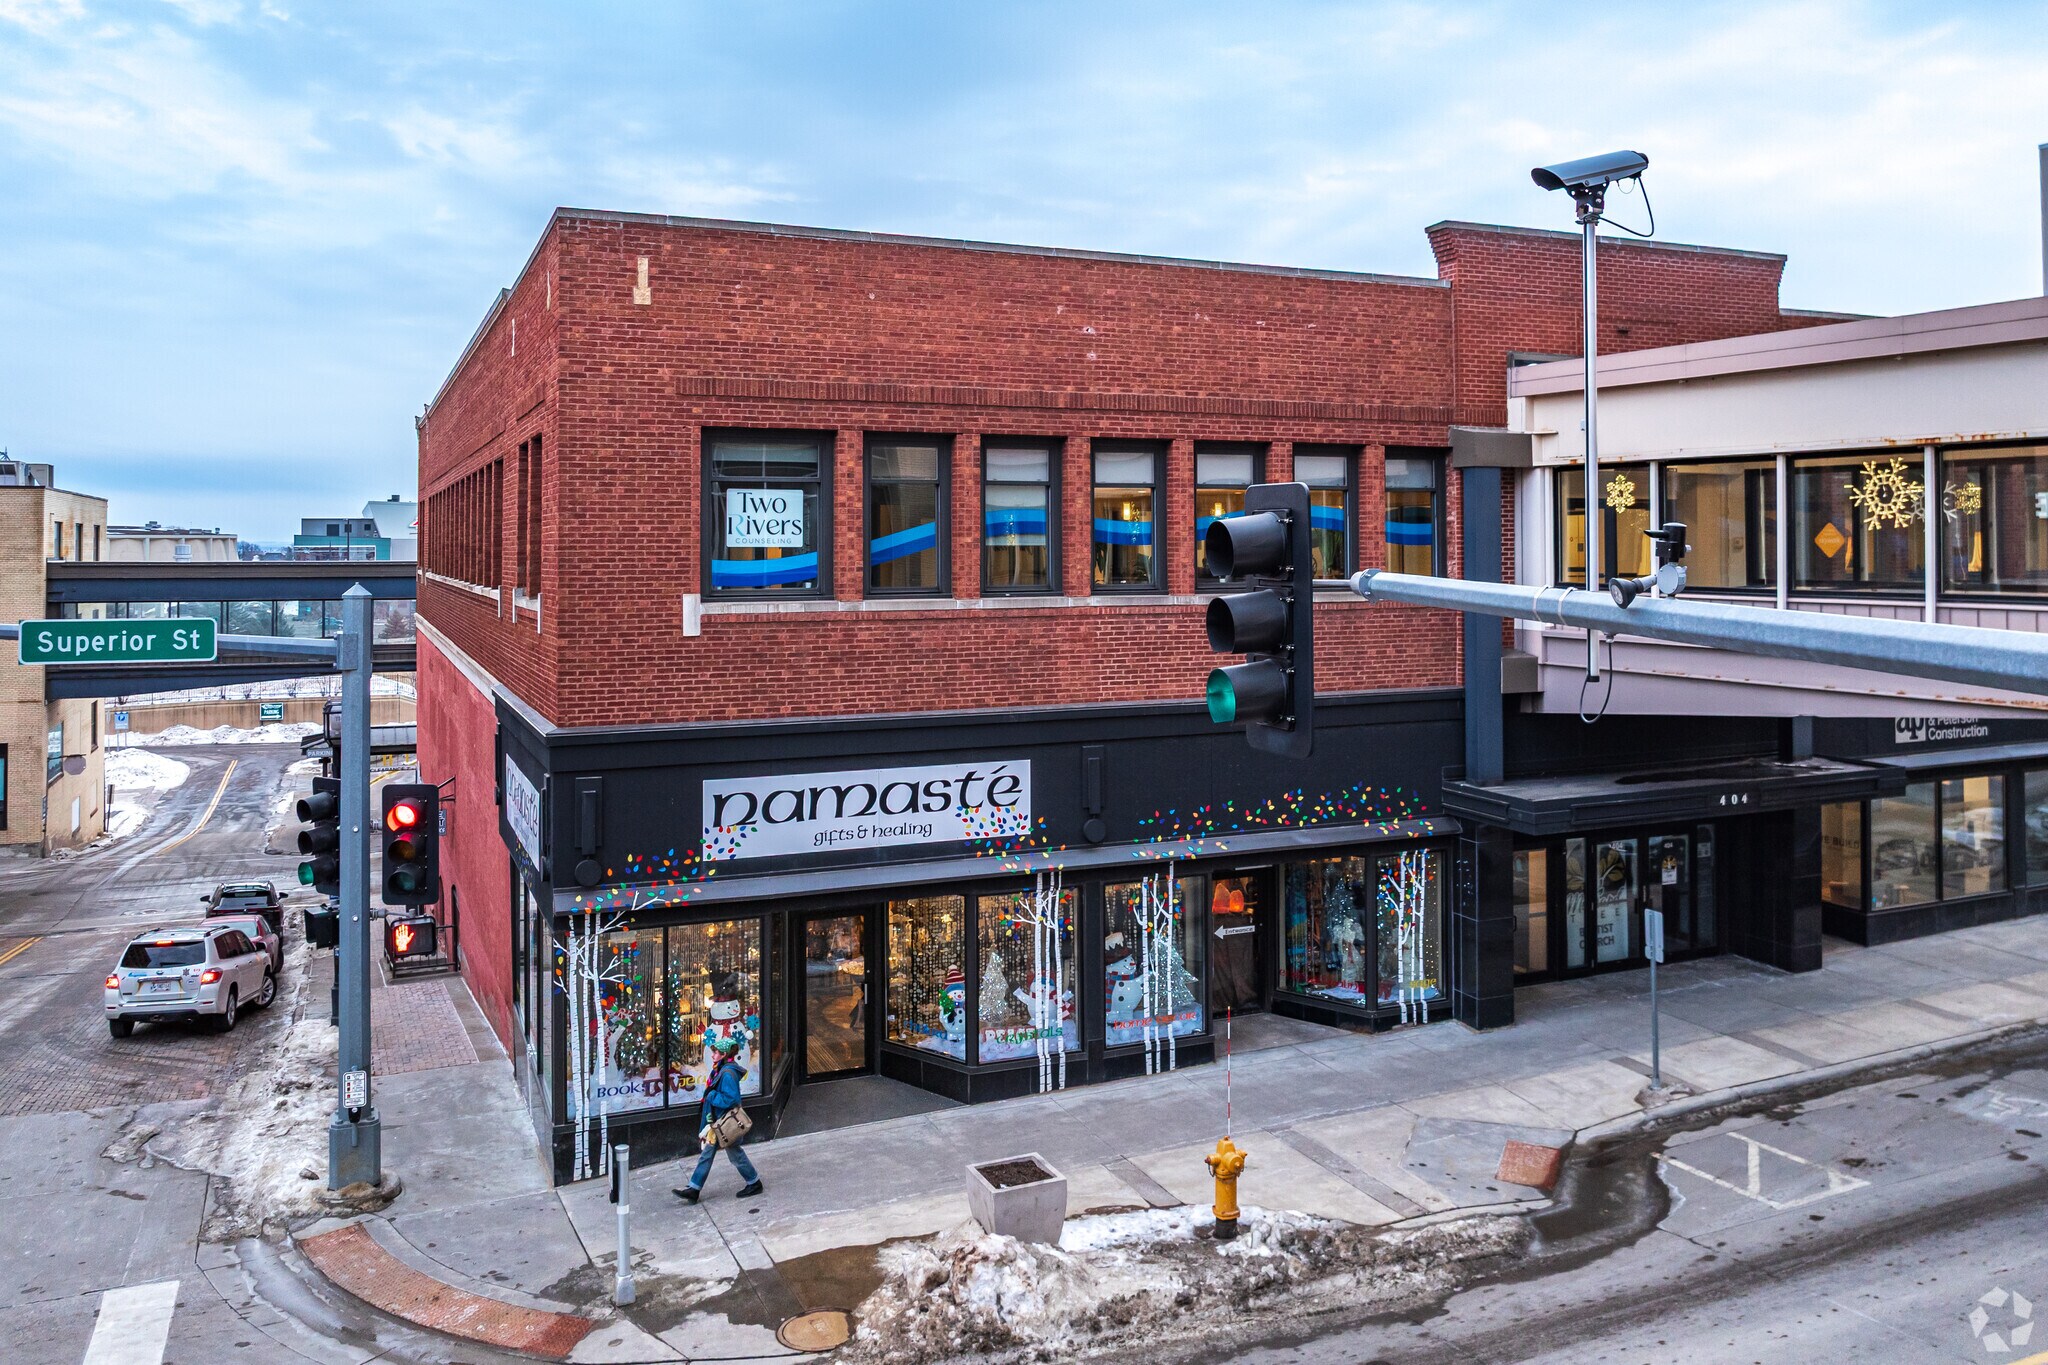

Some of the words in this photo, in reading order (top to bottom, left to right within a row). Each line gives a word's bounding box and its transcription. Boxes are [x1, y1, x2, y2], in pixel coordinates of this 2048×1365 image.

[737, 492, 787, 514] Two
[728, 514, 802, 536] Rivers
[38, 630, 156, 656] Superior
[173, 629, 200, 650] St
[1928, 725, 1988, 740] Construction
[712, 765, 1023, 828] namasté
[1719, 793, 1748, 806] 404
[813, 826, 854, 846] gifts
[857, 828, 867, 839] &
[872, 822, 932, 839] healing
